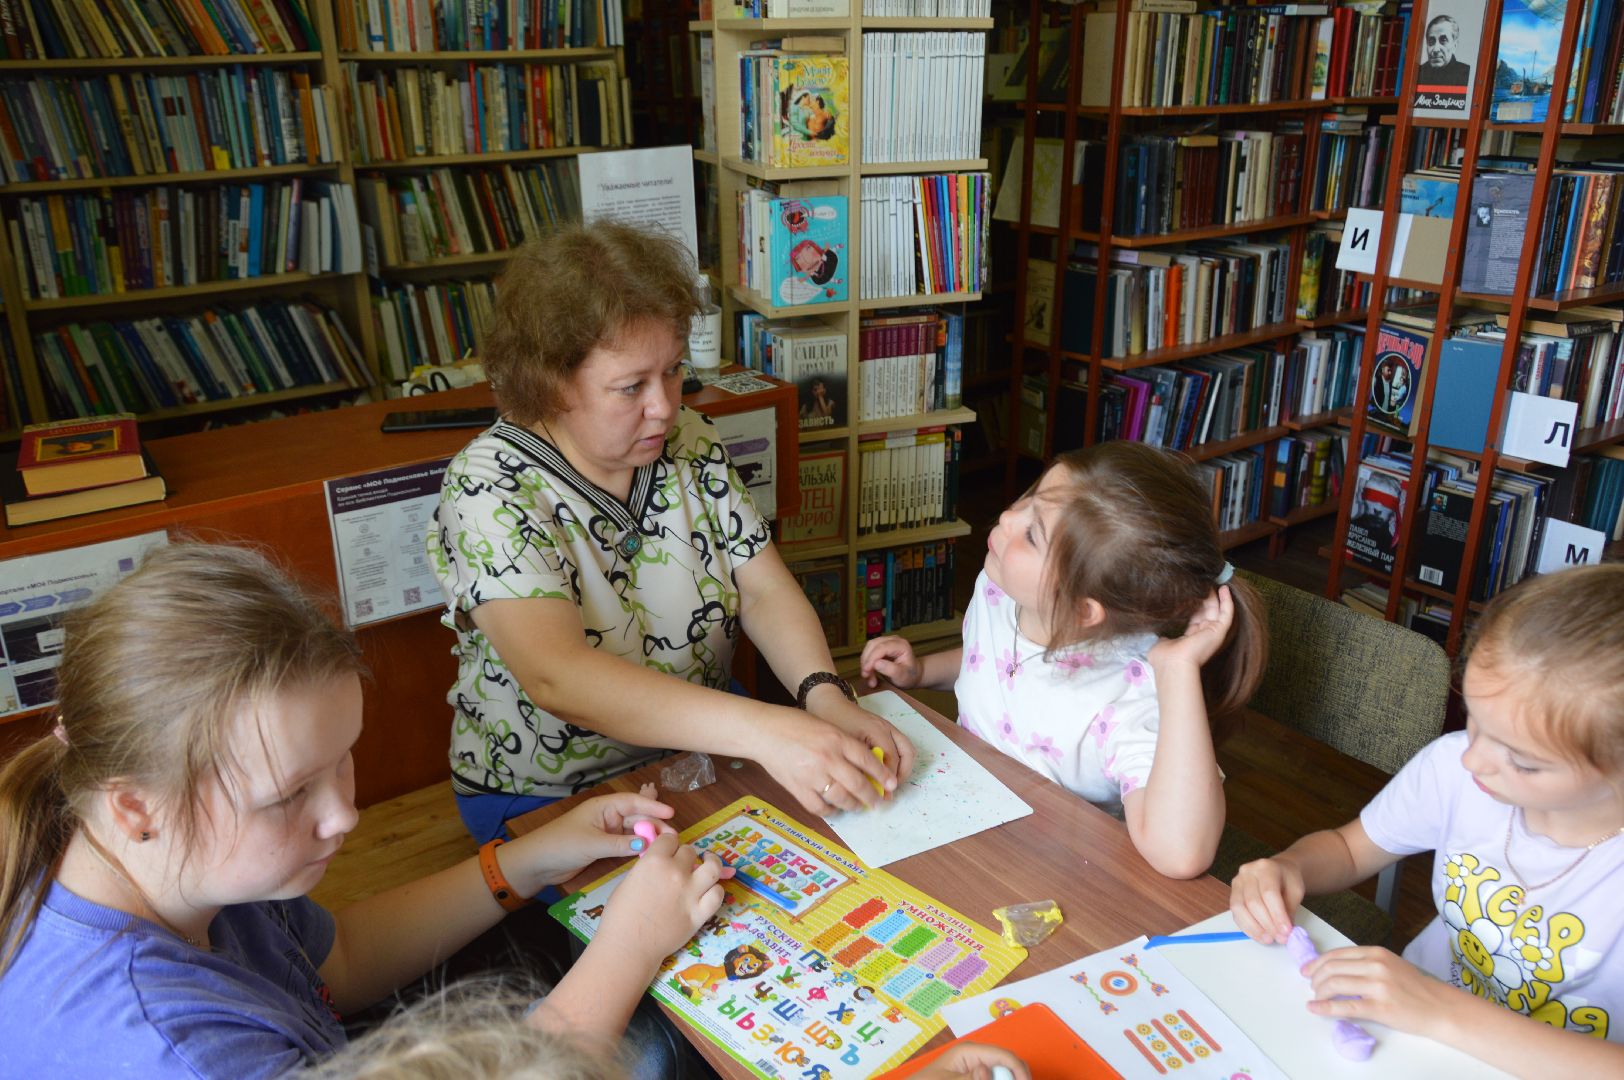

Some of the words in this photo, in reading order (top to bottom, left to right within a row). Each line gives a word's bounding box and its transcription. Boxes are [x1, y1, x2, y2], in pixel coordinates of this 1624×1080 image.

[600, 181, 640, 192] Уважаемые
[1351, 227, 1369, 251] И
[794, 343, 839, 360] САНДРА
[799, 416, 835, 428] ЗАВИСТЬ
[1544, 421, 1570, 448] Л
[336, 484, 362, 493] Сервис
[799, 471, 837, 486] АЛЬЗАК
[801, 486, 835, 511] ТЕЦ
[1346, 539, 1380, 558] ЖЕЛЕЗНЫЙ
[1380, 551, 1394, 564] ПАР
[1565, 544, 1589, 565] М
[0, 586, 26, 595] ортале
[769, 817, 824, 851] АНГЛИЙСКИЙ
[823, 848, 867, 875] АЛФАВИТ
[898, 900, 985, 951] УМНОЖЕНИЯ
[926, 904, 973, 934] ТАБЛИЦА
[745, 923, 792, 958] АЛФАВИТ
[755, 915, 804, 951] РУССКИЙ
[799, 949, 826, 968] П
[717, 998, 748, 1020] Ы
[773, 999, 804, 1022] Ш
[827, 1002, 855, 1021] Х
[736, 1012, 756, 1030] Ь
[856, 1021, 882, 1043] Ц
[774, 1041, 805, 1065] Ю
[840, 1043, 860, 1066] Ъ
